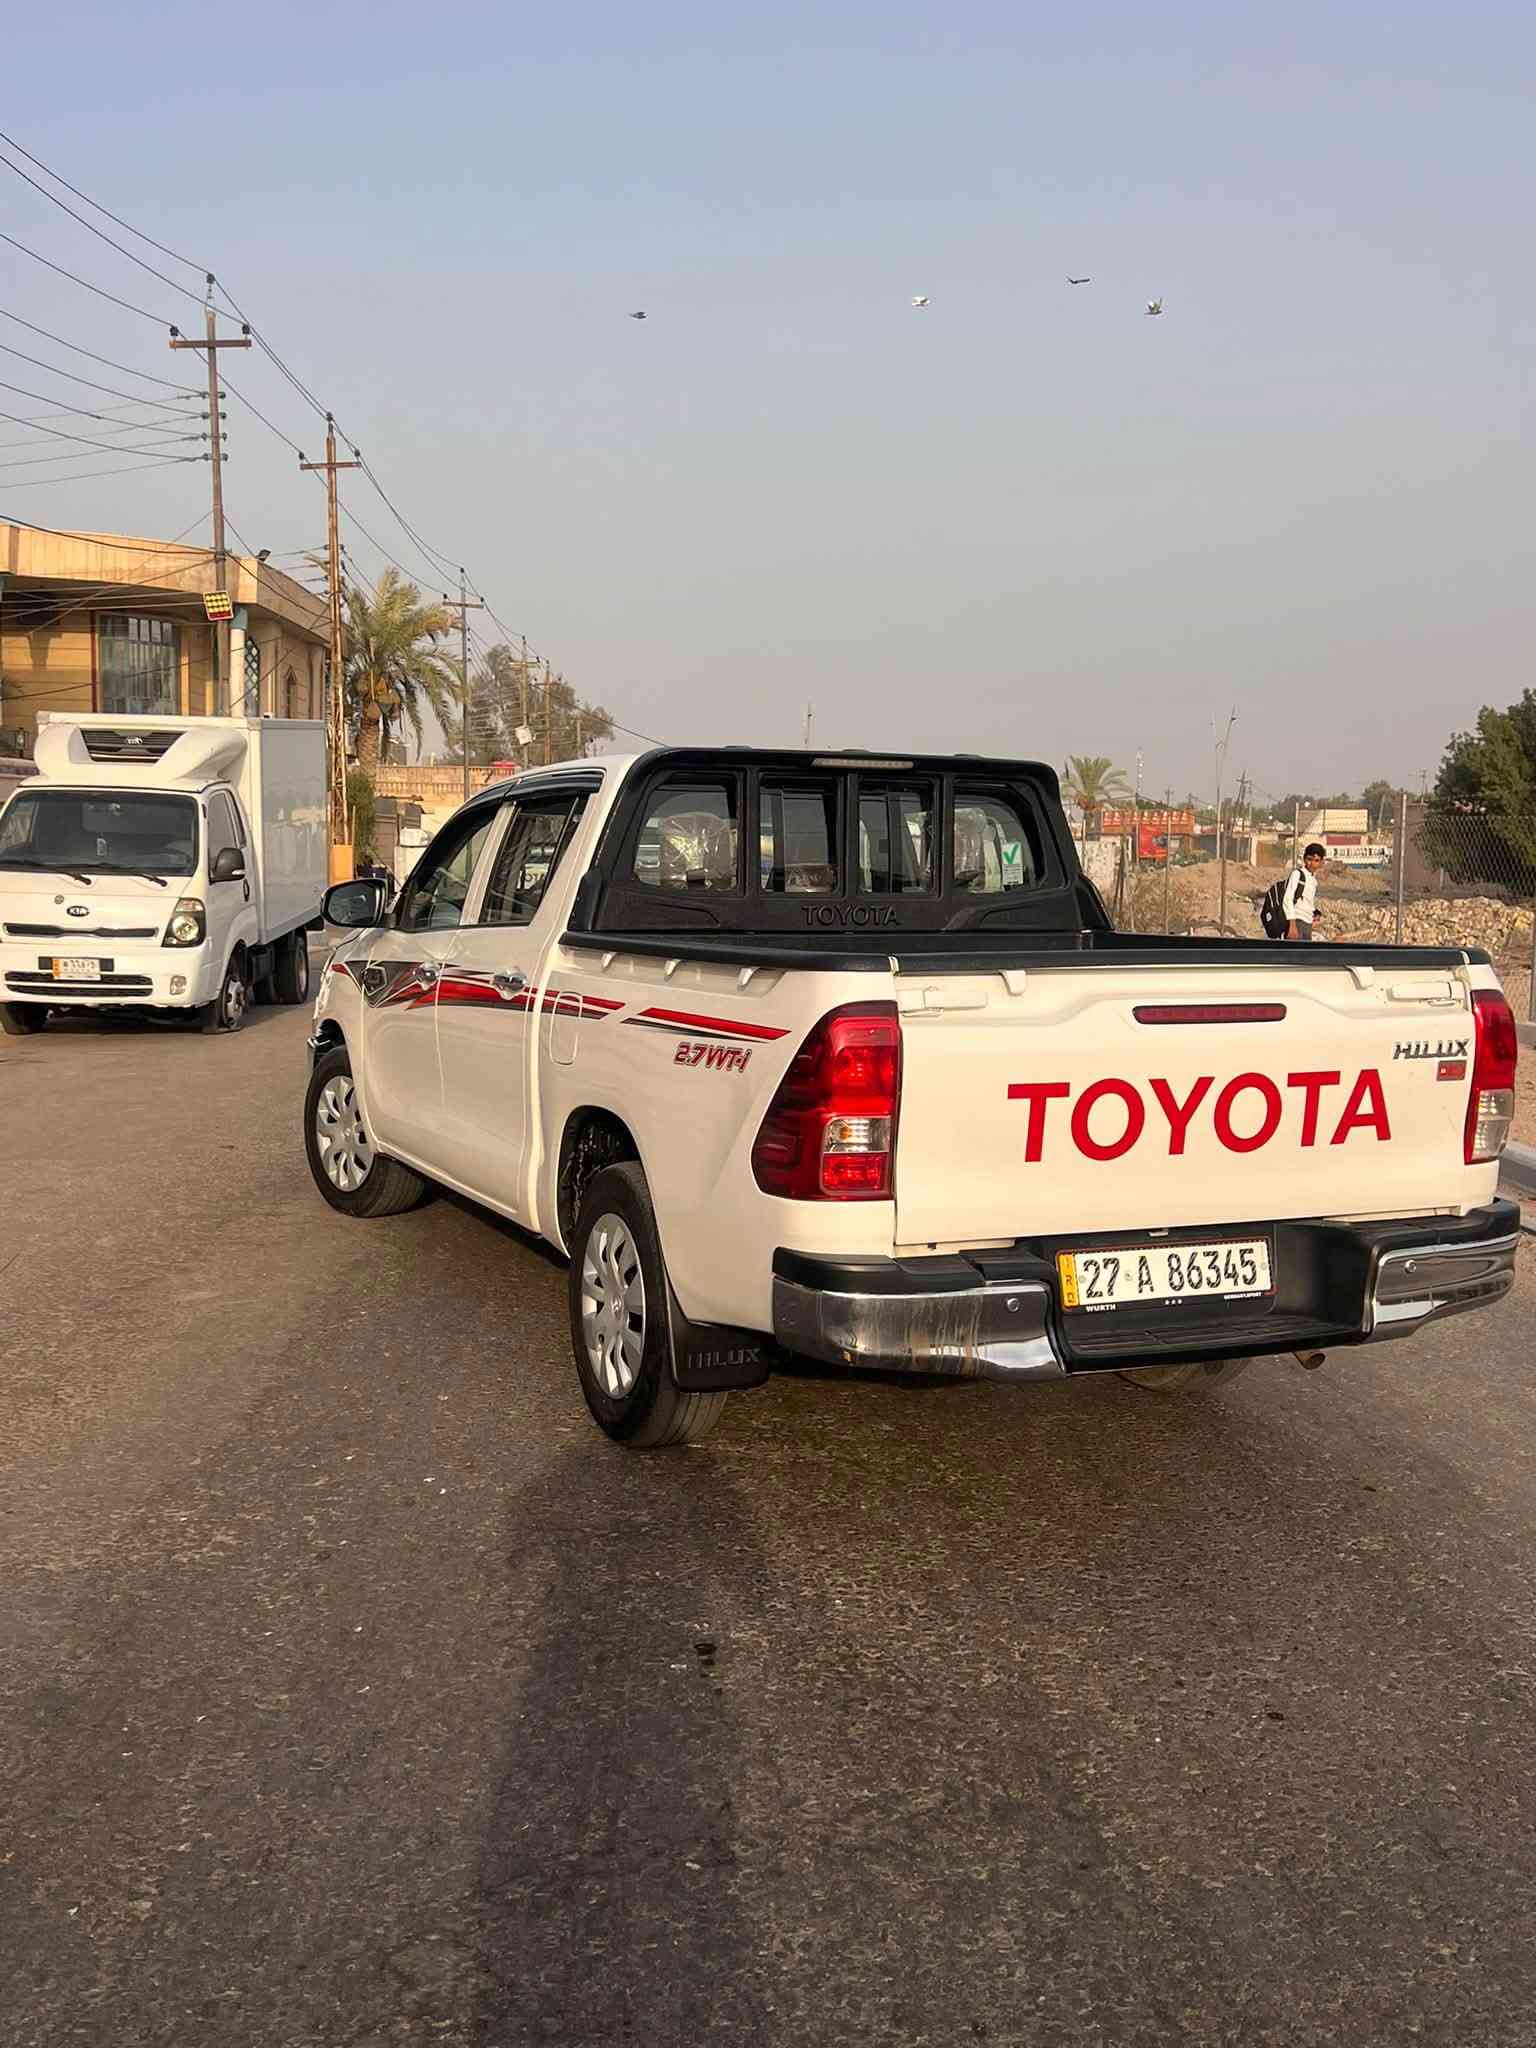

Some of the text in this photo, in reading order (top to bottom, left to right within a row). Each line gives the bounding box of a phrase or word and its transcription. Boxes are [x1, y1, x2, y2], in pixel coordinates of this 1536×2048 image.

[801, 904, 904, 926] TOYOTA
[1393, 1039, 1469, 1060] HILUX
[1007, 1068, 1392, 1163] TOYOTA
[1083, 1247, 1257, 1299] 27 A 86345
[688, 1346, 761, 1369] HILUX
